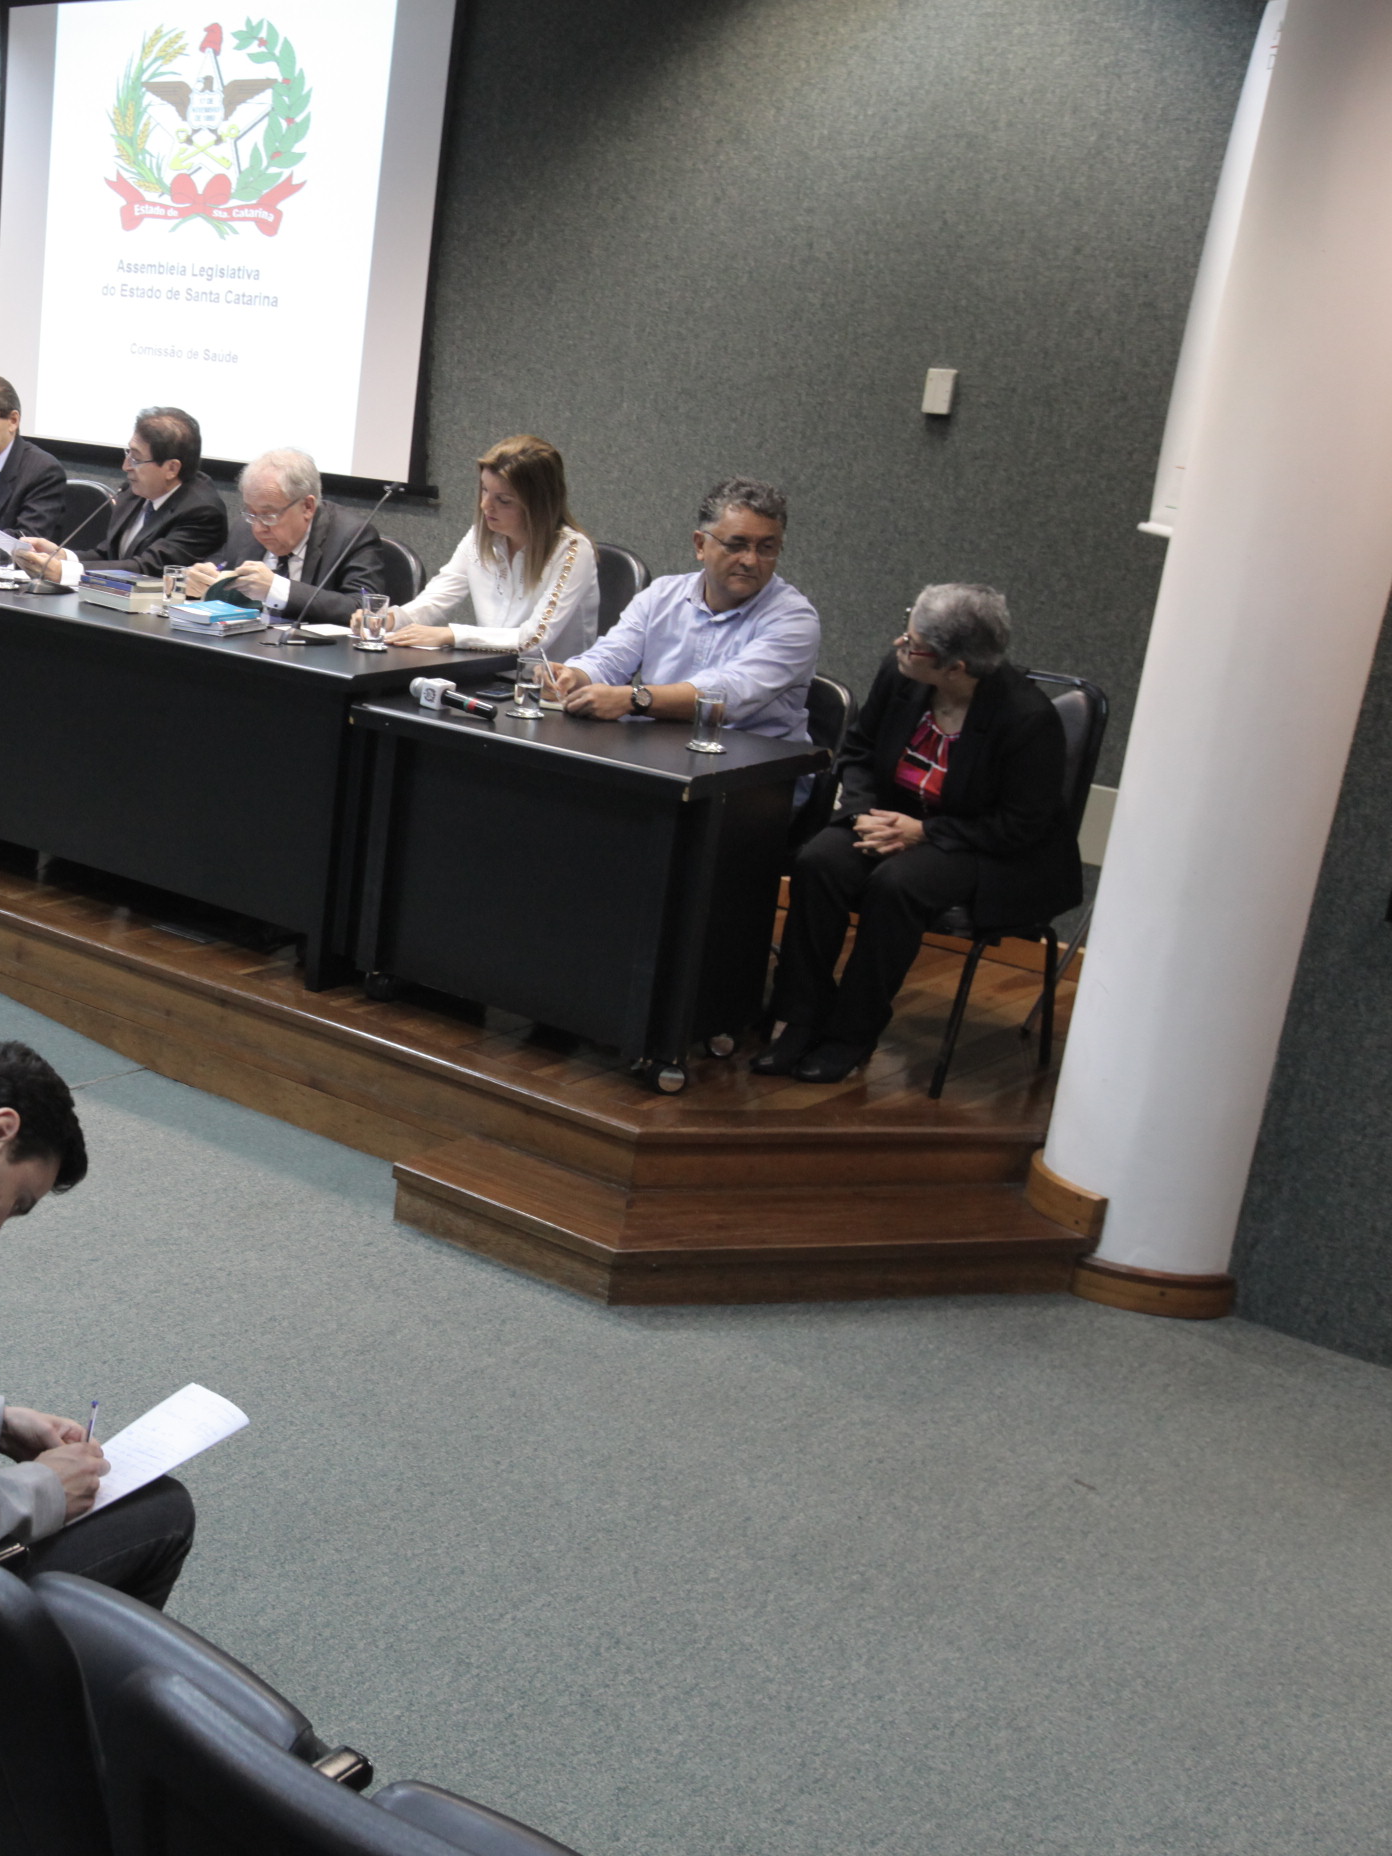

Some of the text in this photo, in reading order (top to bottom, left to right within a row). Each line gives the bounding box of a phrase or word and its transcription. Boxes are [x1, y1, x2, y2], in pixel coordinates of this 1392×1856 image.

[134, 204, 165, 216] Estado
[167, 208, 179, 217] de
[232, 208, 275, 222] Catarina
[117, 259, 261, 281] Assembleia Legislativa
[102, 283, 279, 308] do Estado de Santa Catarina
[130, 342, 239, 364] Comissão de Saúde
